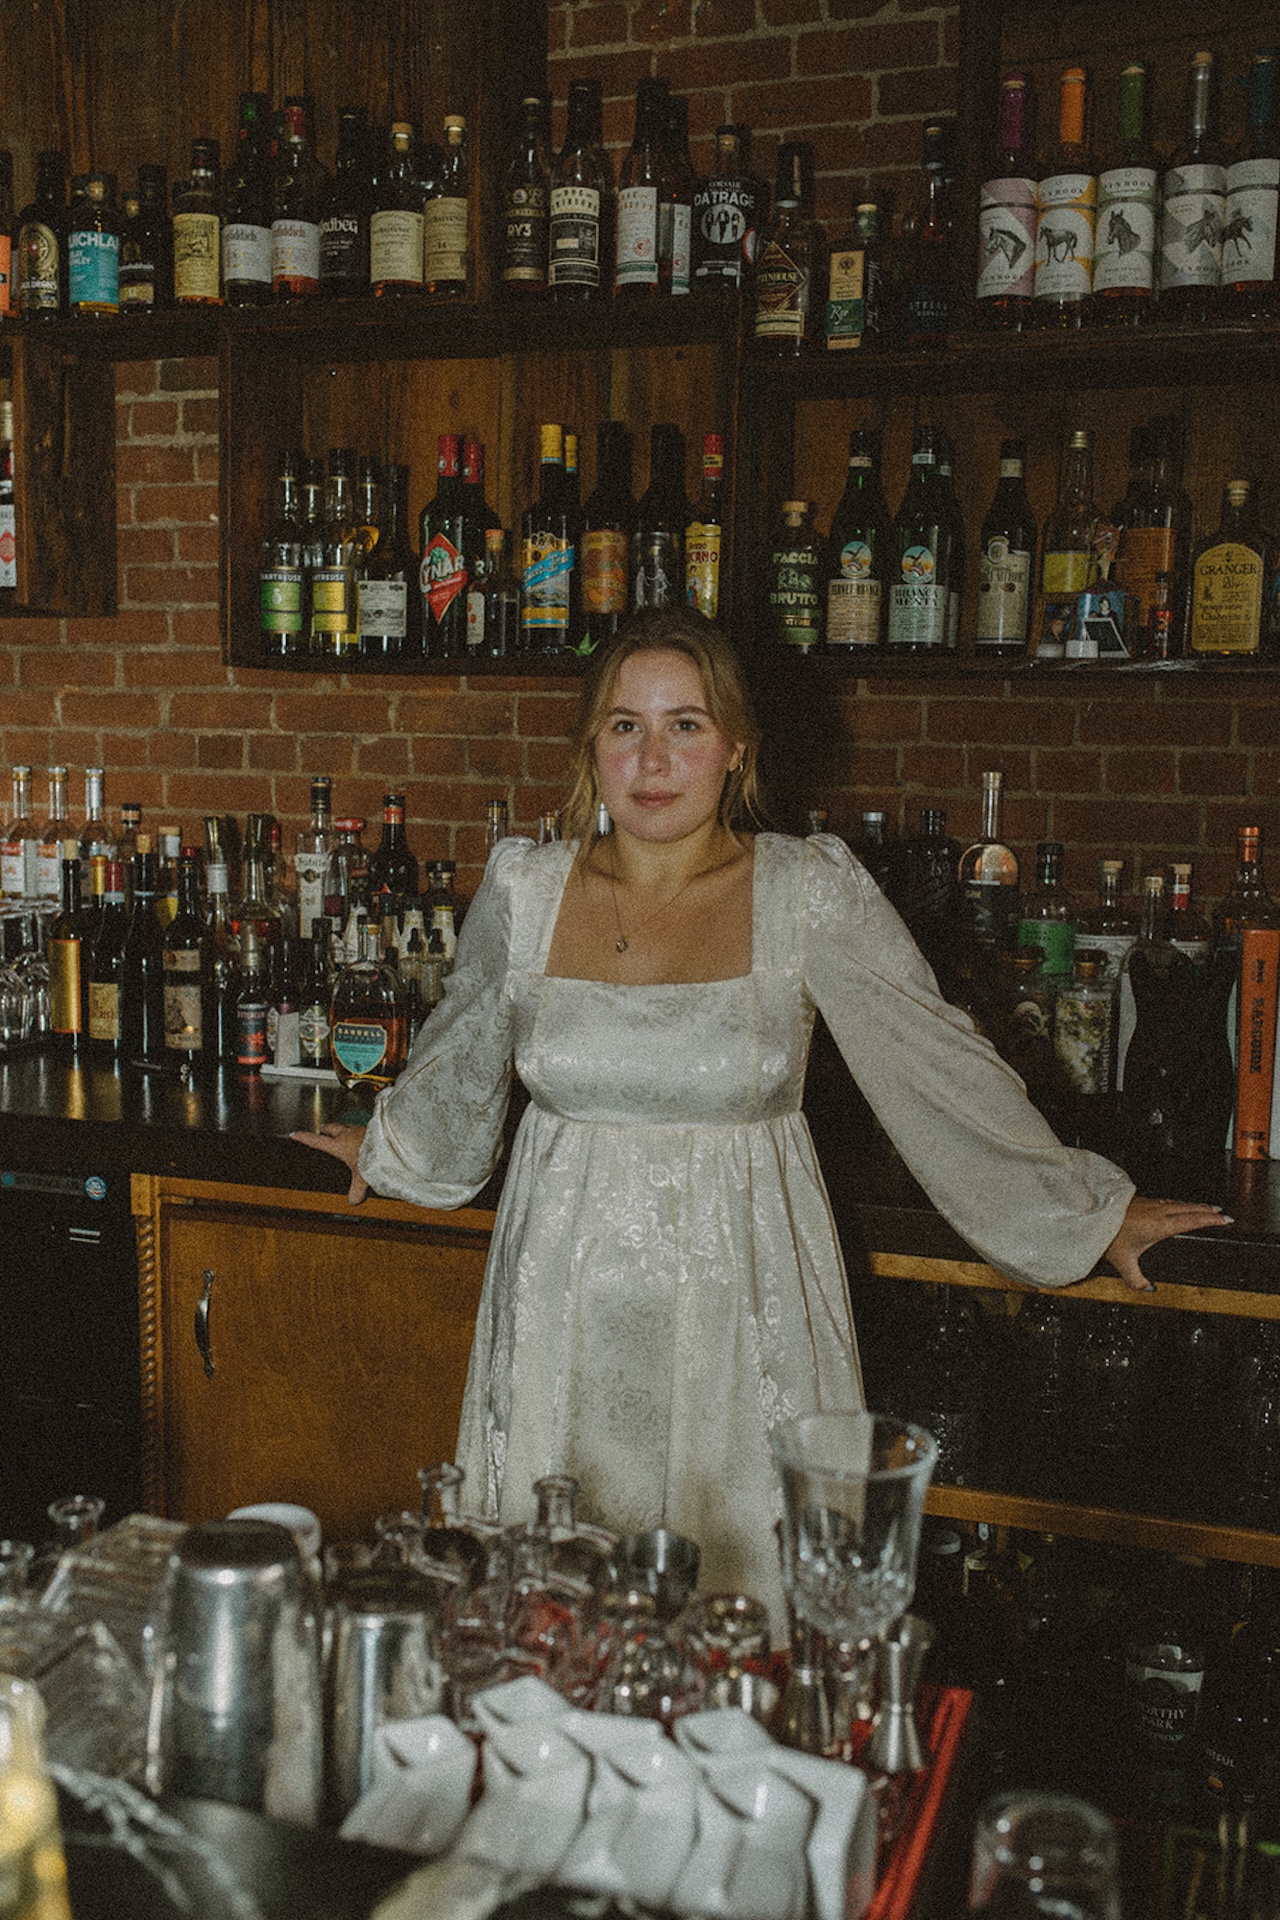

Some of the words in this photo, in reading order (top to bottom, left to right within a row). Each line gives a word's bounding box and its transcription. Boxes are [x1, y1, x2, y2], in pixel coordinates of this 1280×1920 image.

[693, 191, 756, 209] OATRAGE
[507, 222, 533, 237] RY3
[772, 552, 820, 565] FACCIA
[1200, 563, 1257, 577] GRANGER
[769, 592, 819, 606] BRUTTO
